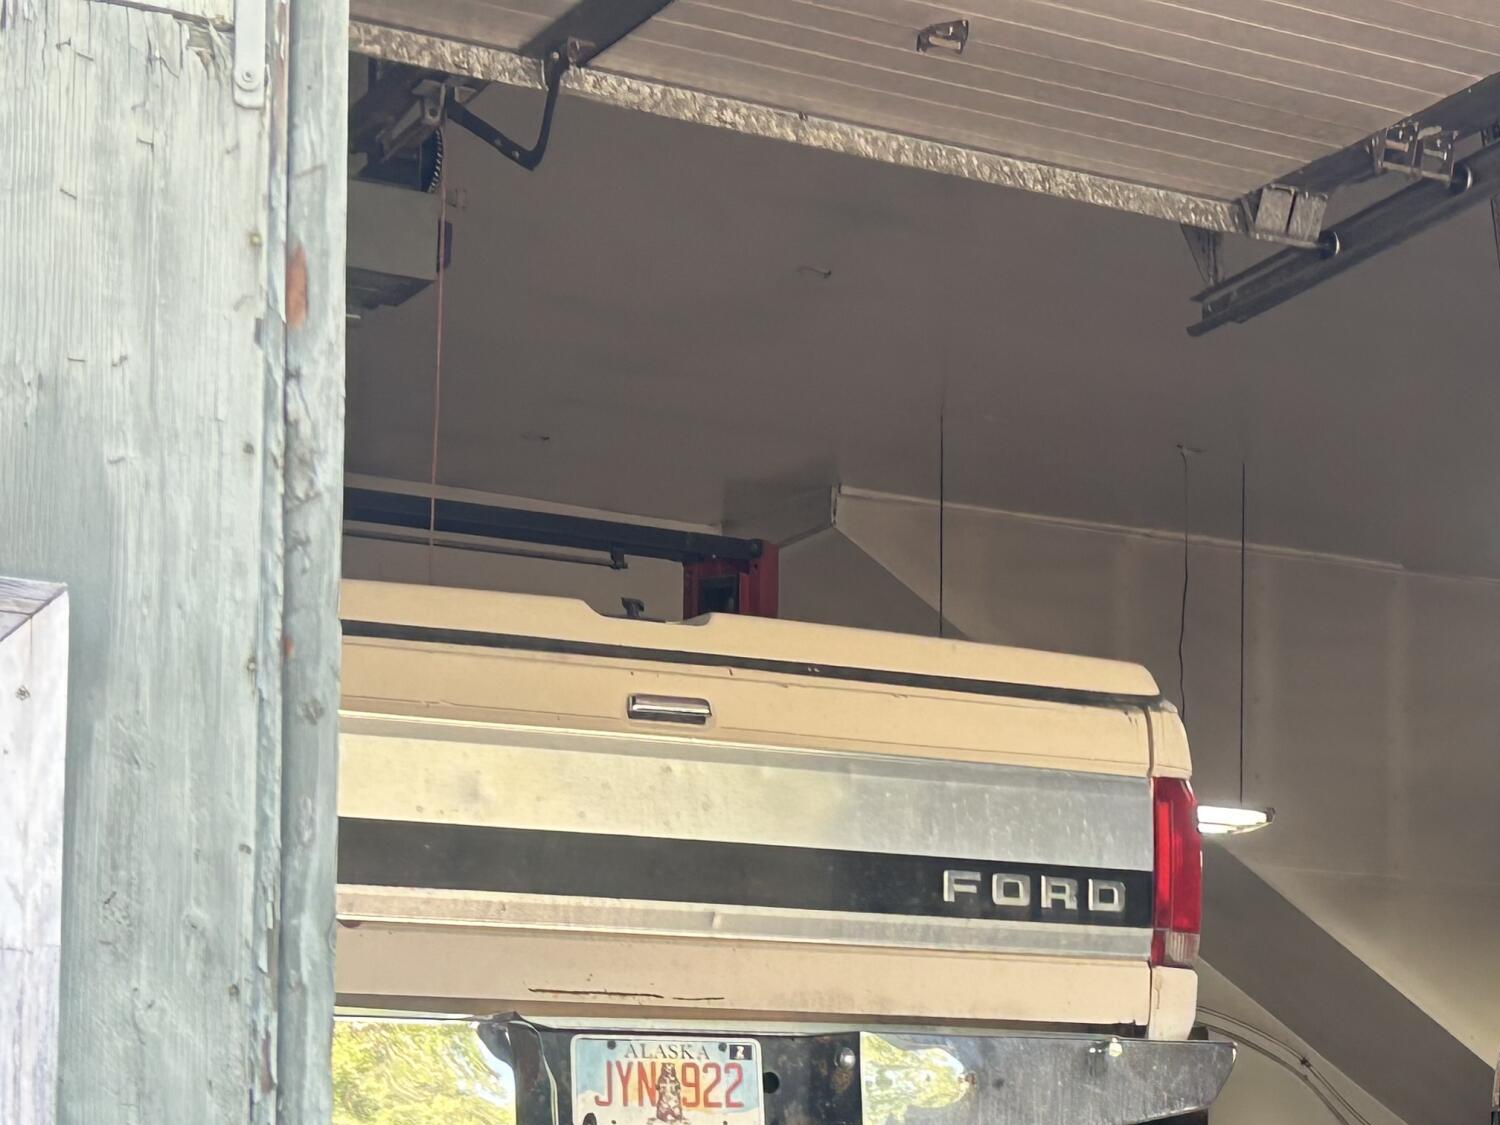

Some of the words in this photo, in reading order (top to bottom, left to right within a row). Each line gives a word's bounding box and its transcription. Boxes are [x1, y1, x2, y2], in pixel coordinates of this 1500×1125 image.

[943, 869, 1126, 912] FORD
[624, 1043, 711, 1060] ALASKA
[594, 1061, 658, 1108] JYN
[681, 1062, 745, 1109] 922
